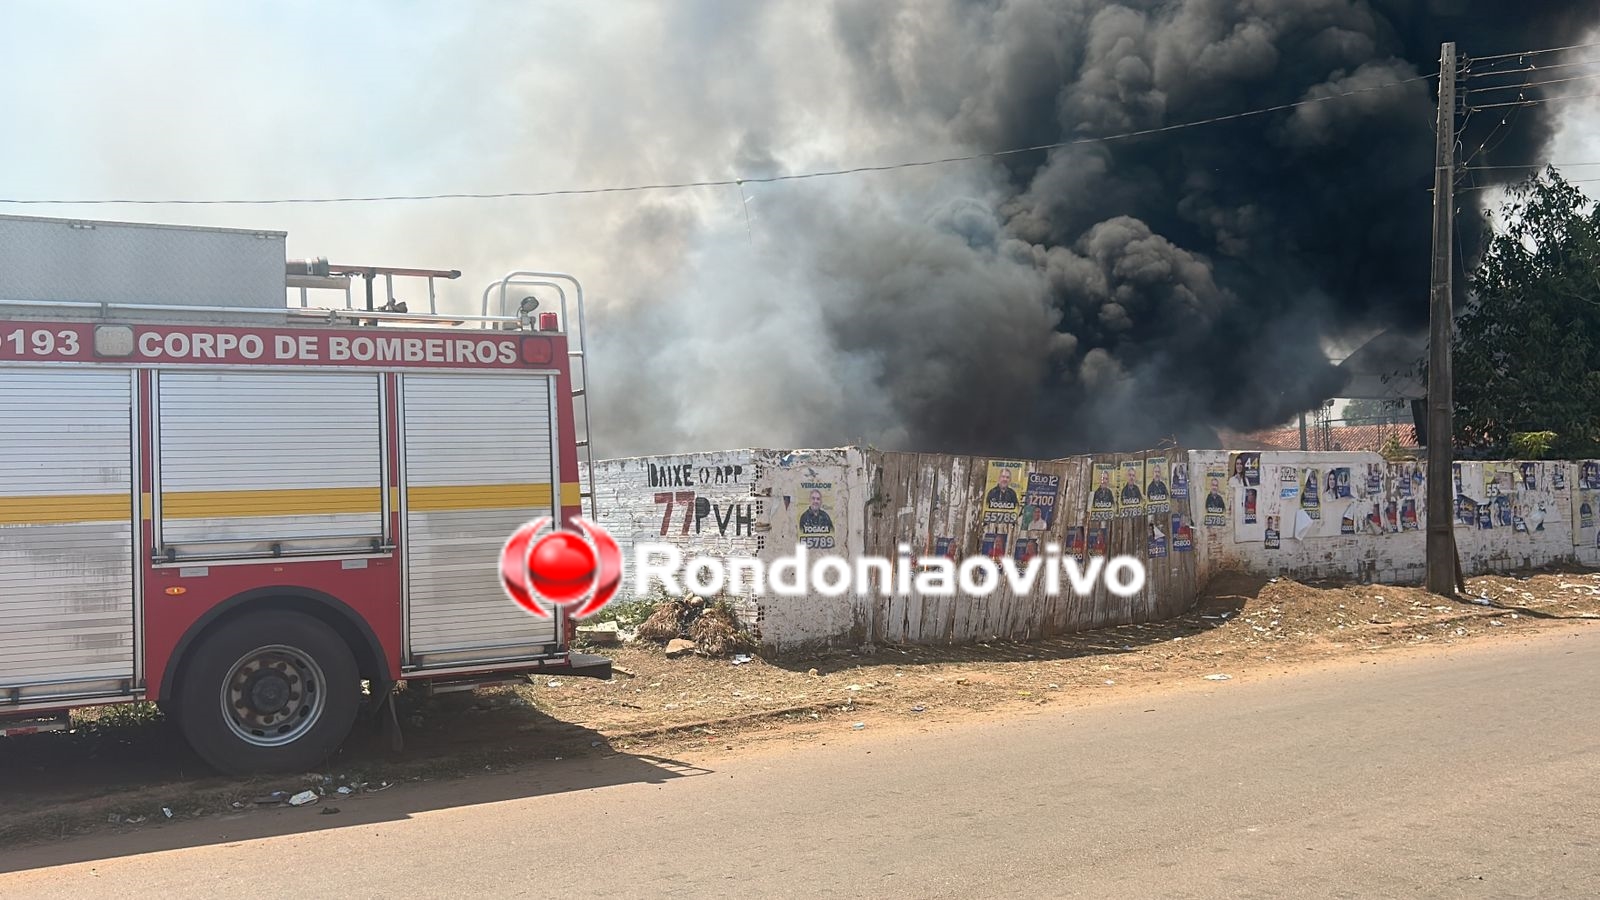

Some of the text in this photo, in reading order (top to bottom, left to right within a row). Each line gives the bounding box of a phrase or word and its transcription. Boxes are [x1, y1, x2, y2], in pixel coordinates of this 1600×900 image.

[0, 329, 80, 355] 193
[138, 332, 517, 364] CORPO DE BOMBEIROS
[1244, 457, 1260, 470] 44
[647, 463, 694, 487] BAIXE
[714, 465, 743, 484] APP
[1048, 475, 1059, 487] 12
[984, 511, 1018, 523] 55789
